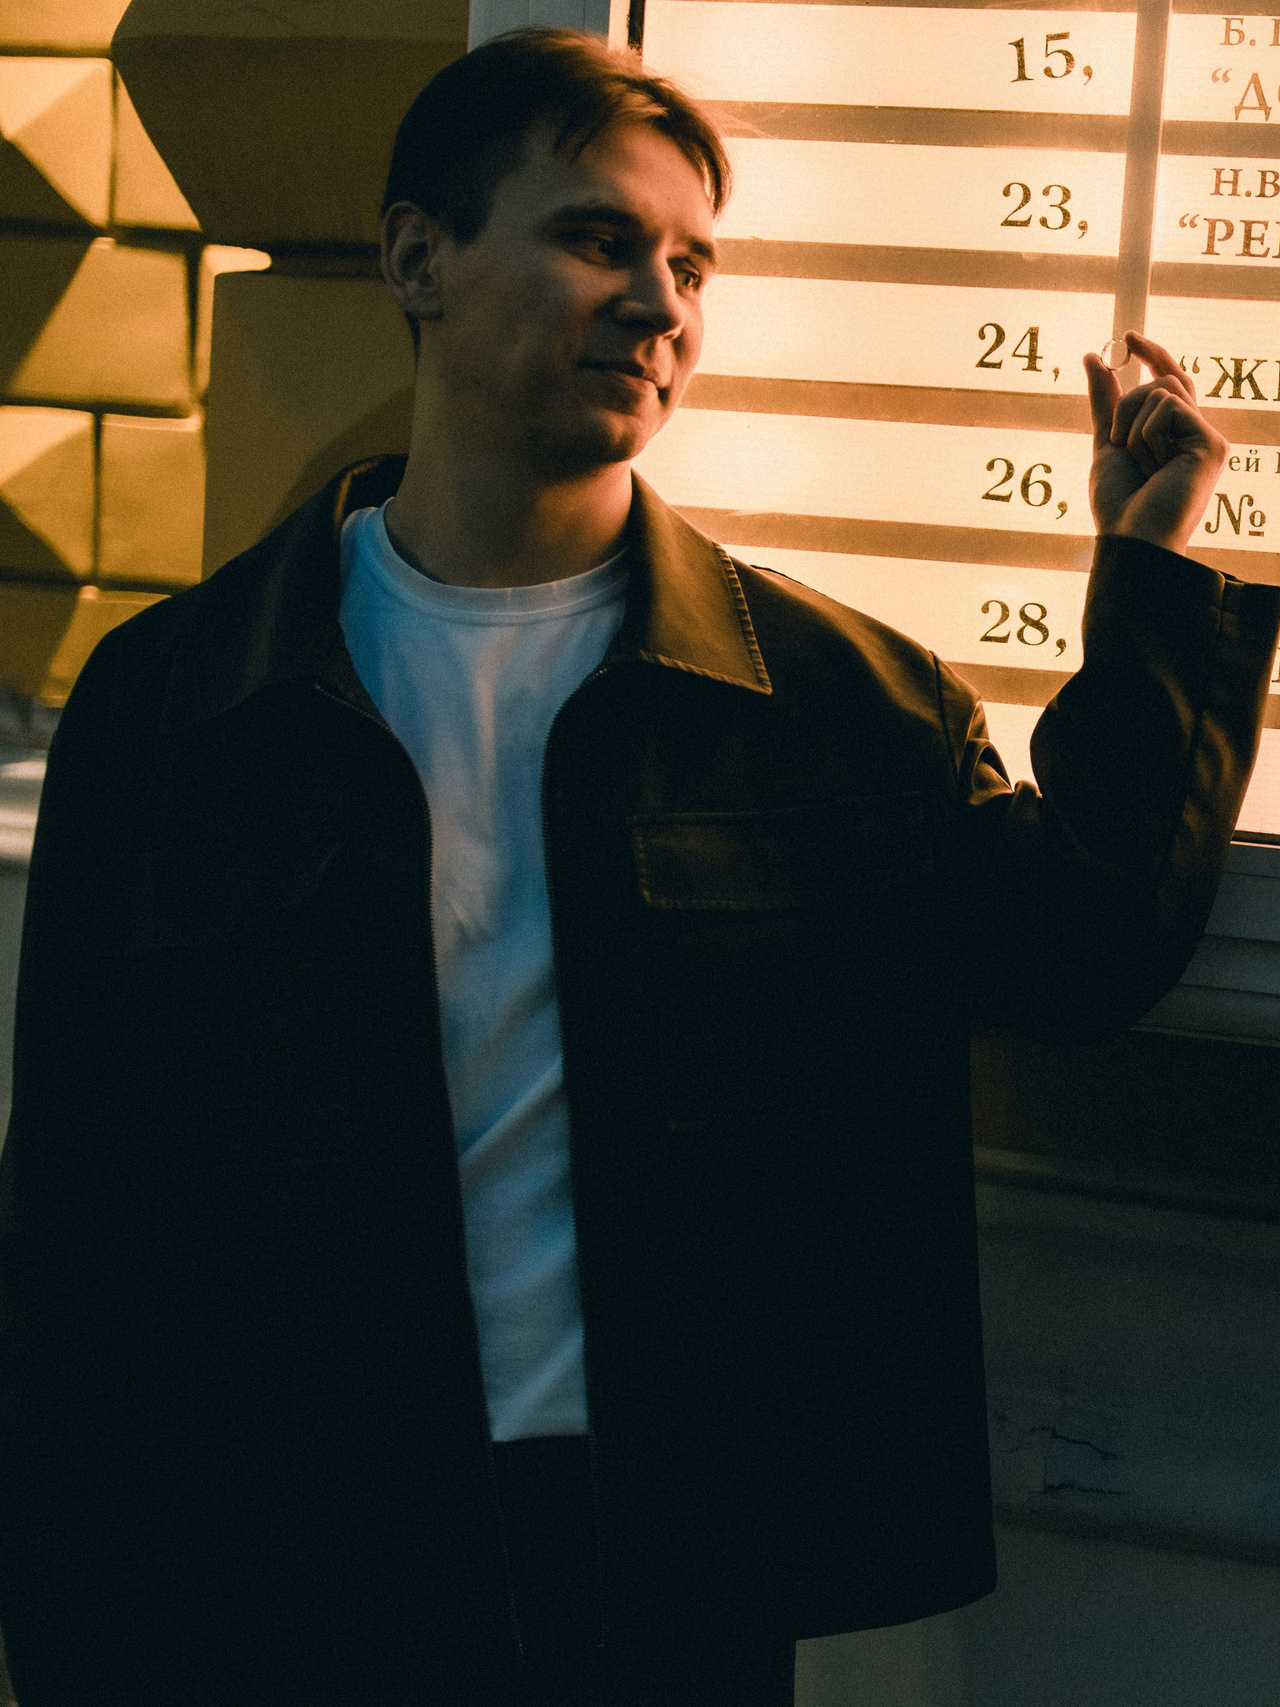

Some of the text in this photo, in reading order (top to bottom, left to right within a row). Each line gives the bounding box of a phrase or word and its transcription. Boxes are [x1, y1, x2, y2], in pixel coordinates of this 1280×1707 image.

[1008, 32, 1094, 86] 15,
[1220, 17, 1257, 47] Б.
[1000, 181, 1089, 240] 23,
[975, 322, 1061, 381] 24,
[981, 457, 1069, 520] 26,
[1205, 493, 1267, 537] №
[979, 600, 1068, 657] 28,
